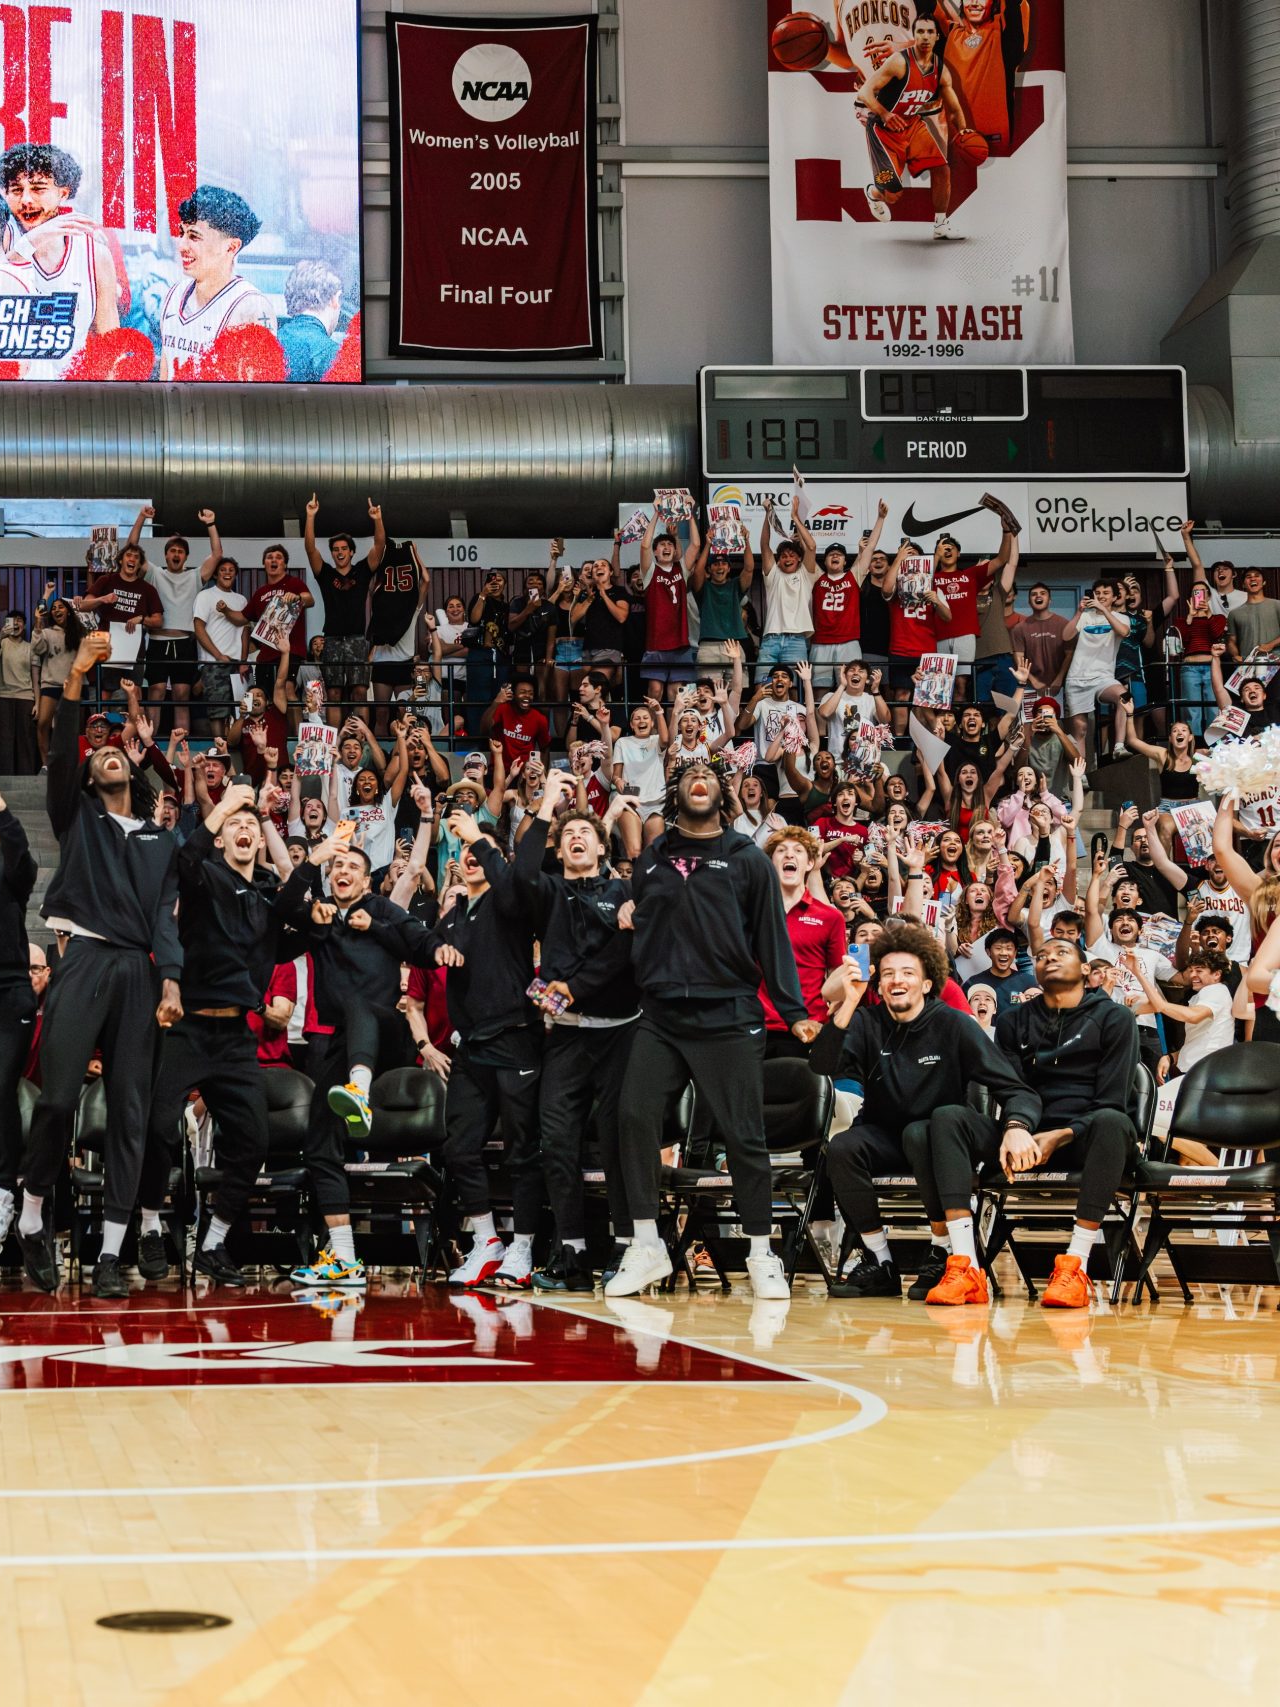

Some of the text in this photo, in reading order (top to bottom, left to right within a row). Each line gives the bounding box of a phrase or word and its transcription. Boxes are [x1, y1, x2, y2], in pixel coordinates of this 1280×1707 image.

[845, 0, 912, 40] BRONCOS
[460, 80, 529, 101] NCAA
[100, 9, 197, 237] IN
[409, 128, 580, 152] Women’s Volleyball
[470, 172, 521, 190] 2005
[461, 227, 529, 246] NCAA
[440, 284, 553, 305] Final Four
[1011, 266, 1060, 303] #11
[823, 304, 1023, 341] STEVE NASH
[883, 344, 964, 357] 1992-1996
[906, 441, 967, 458] PERIOD
[745, 492, 790, 507] MRC
[1035, 497, 1088, 514] one
[1036, 508, 1183, 541] workplace
[447, 545, 478, 561] 106
[384, 565, 414, 592] 15
[822, 592, 845, 611] 22
[1257, 804, 1276, 827] 11
[1202, 896, 1245, 915] RONCOS
